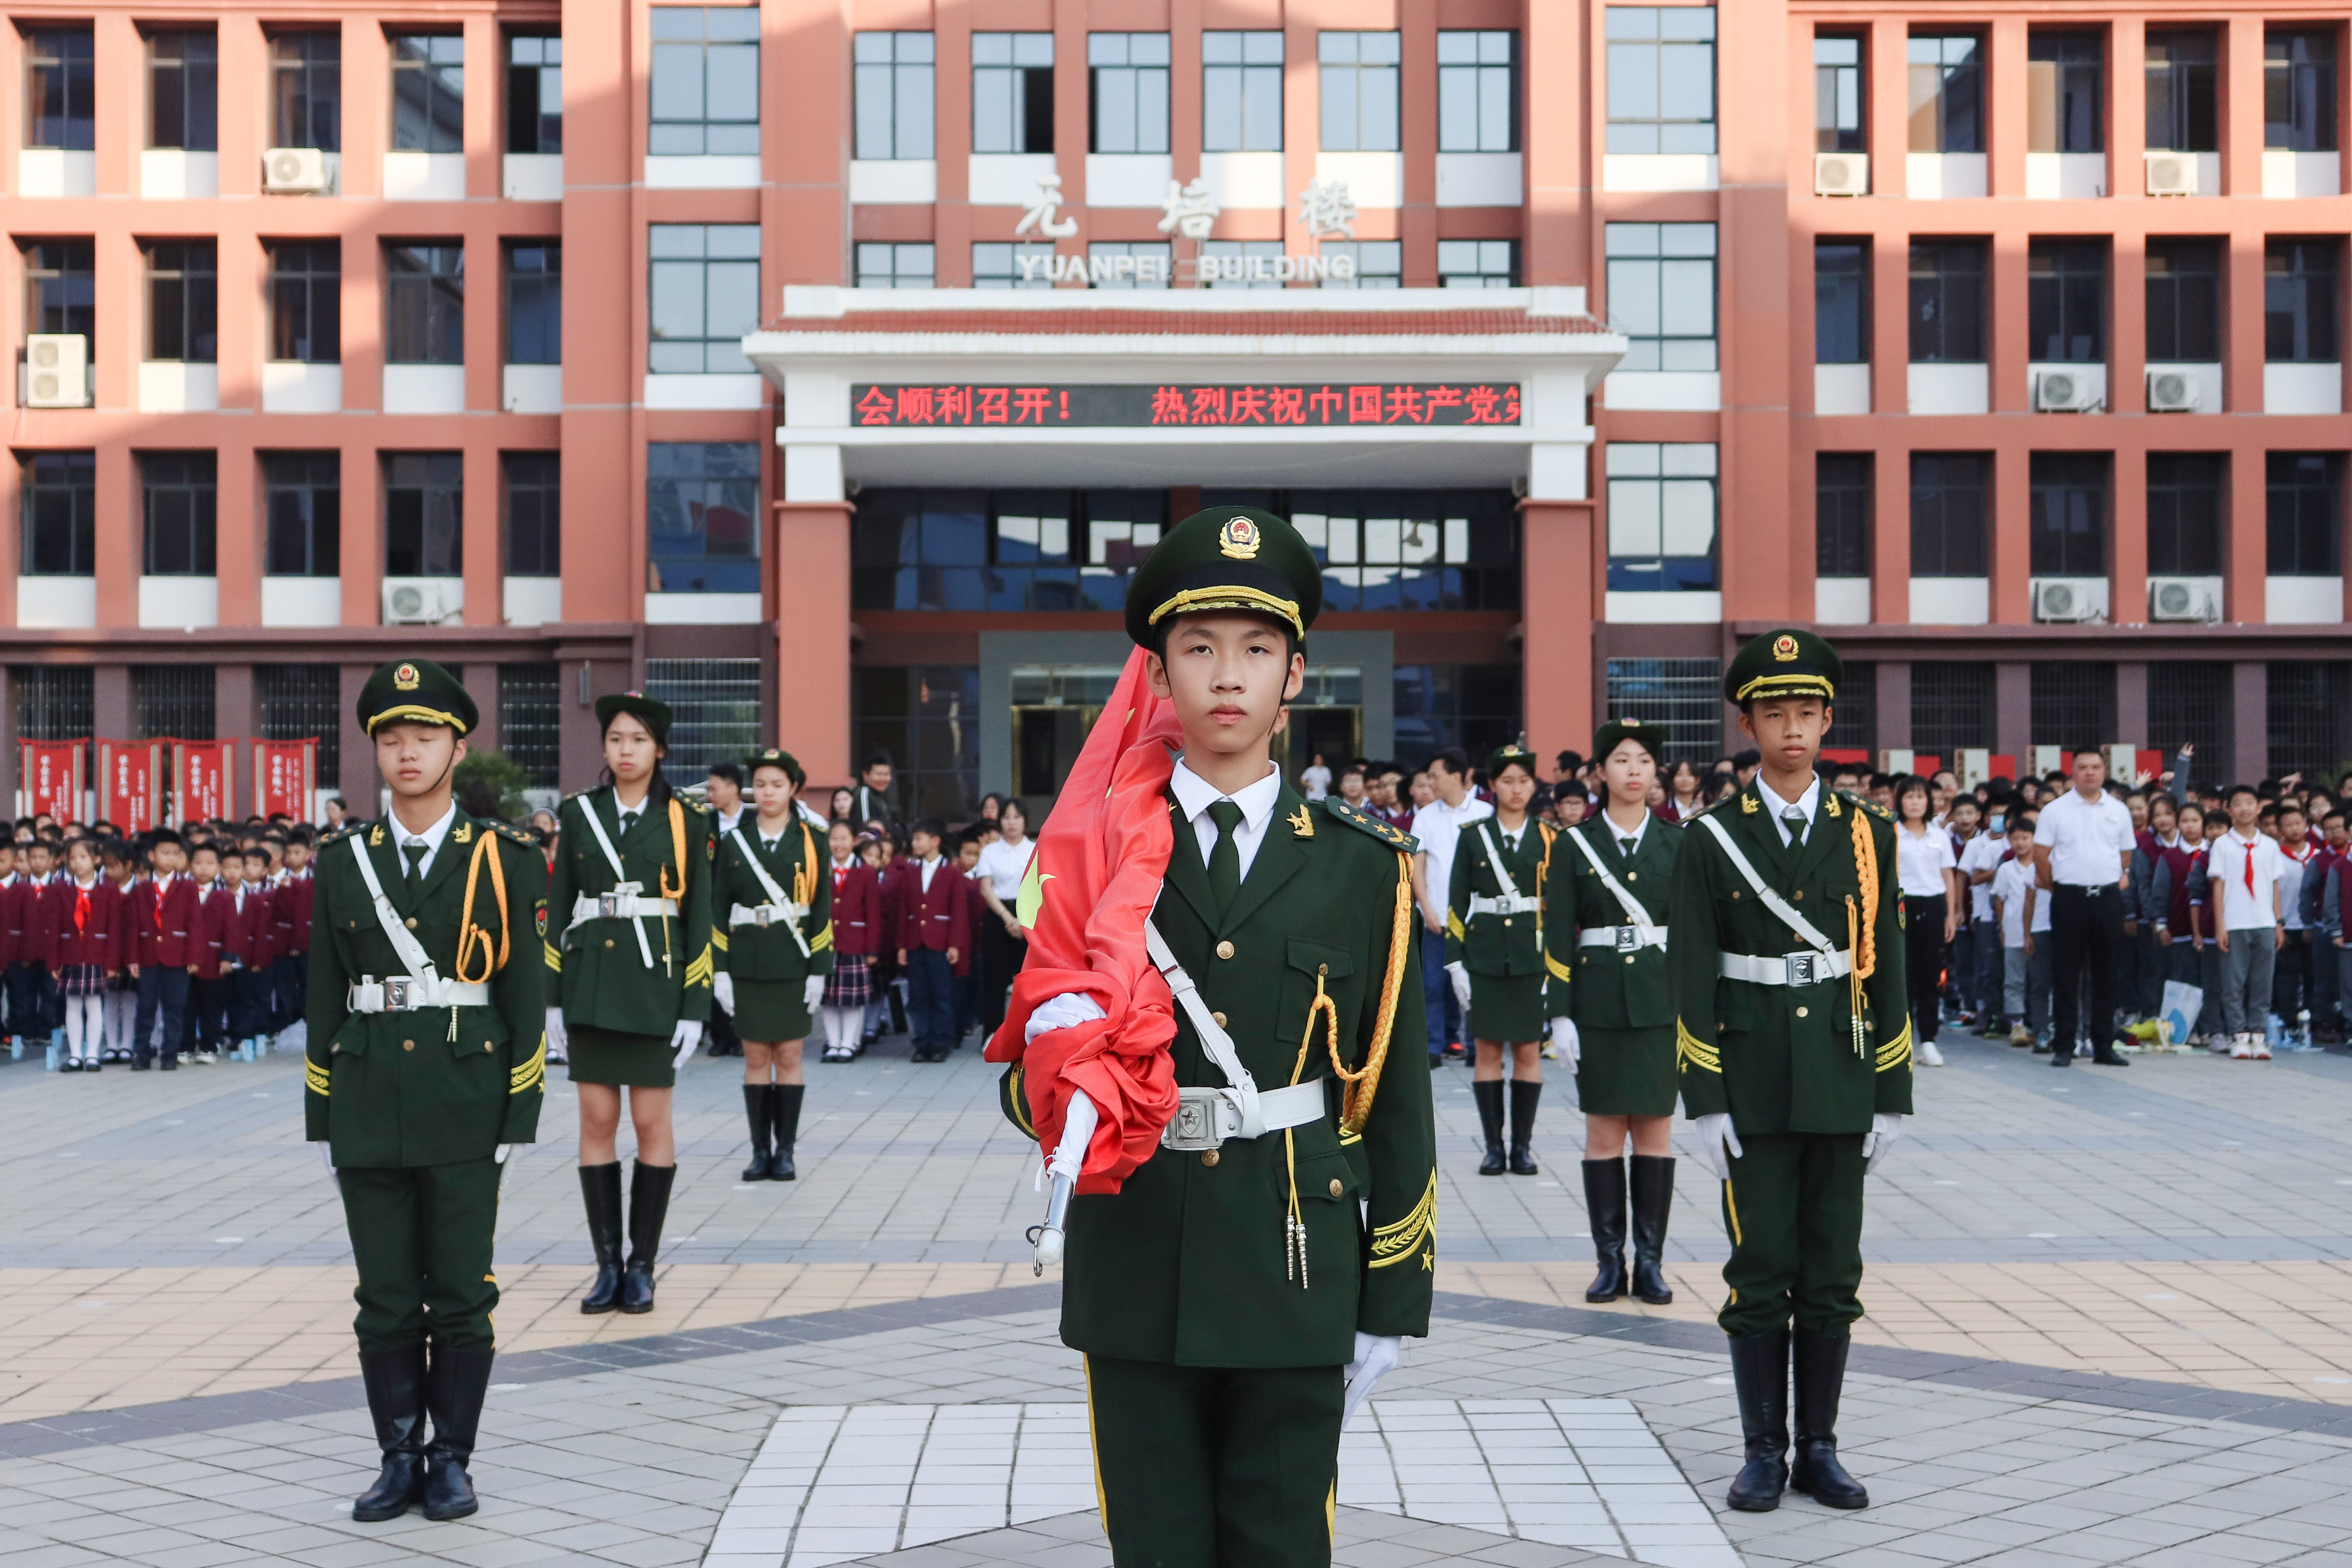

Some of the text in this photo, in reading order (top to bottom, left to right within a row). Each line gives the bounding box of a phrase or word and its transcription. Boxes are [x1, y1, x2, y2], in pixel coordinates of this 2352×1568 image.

[1015, 174, 1358, 238] 元培楼
[1015, 254, 1355, 281] YUANPEI BUILDING
[855, 386, 1070, 426] 会顺利召开！
